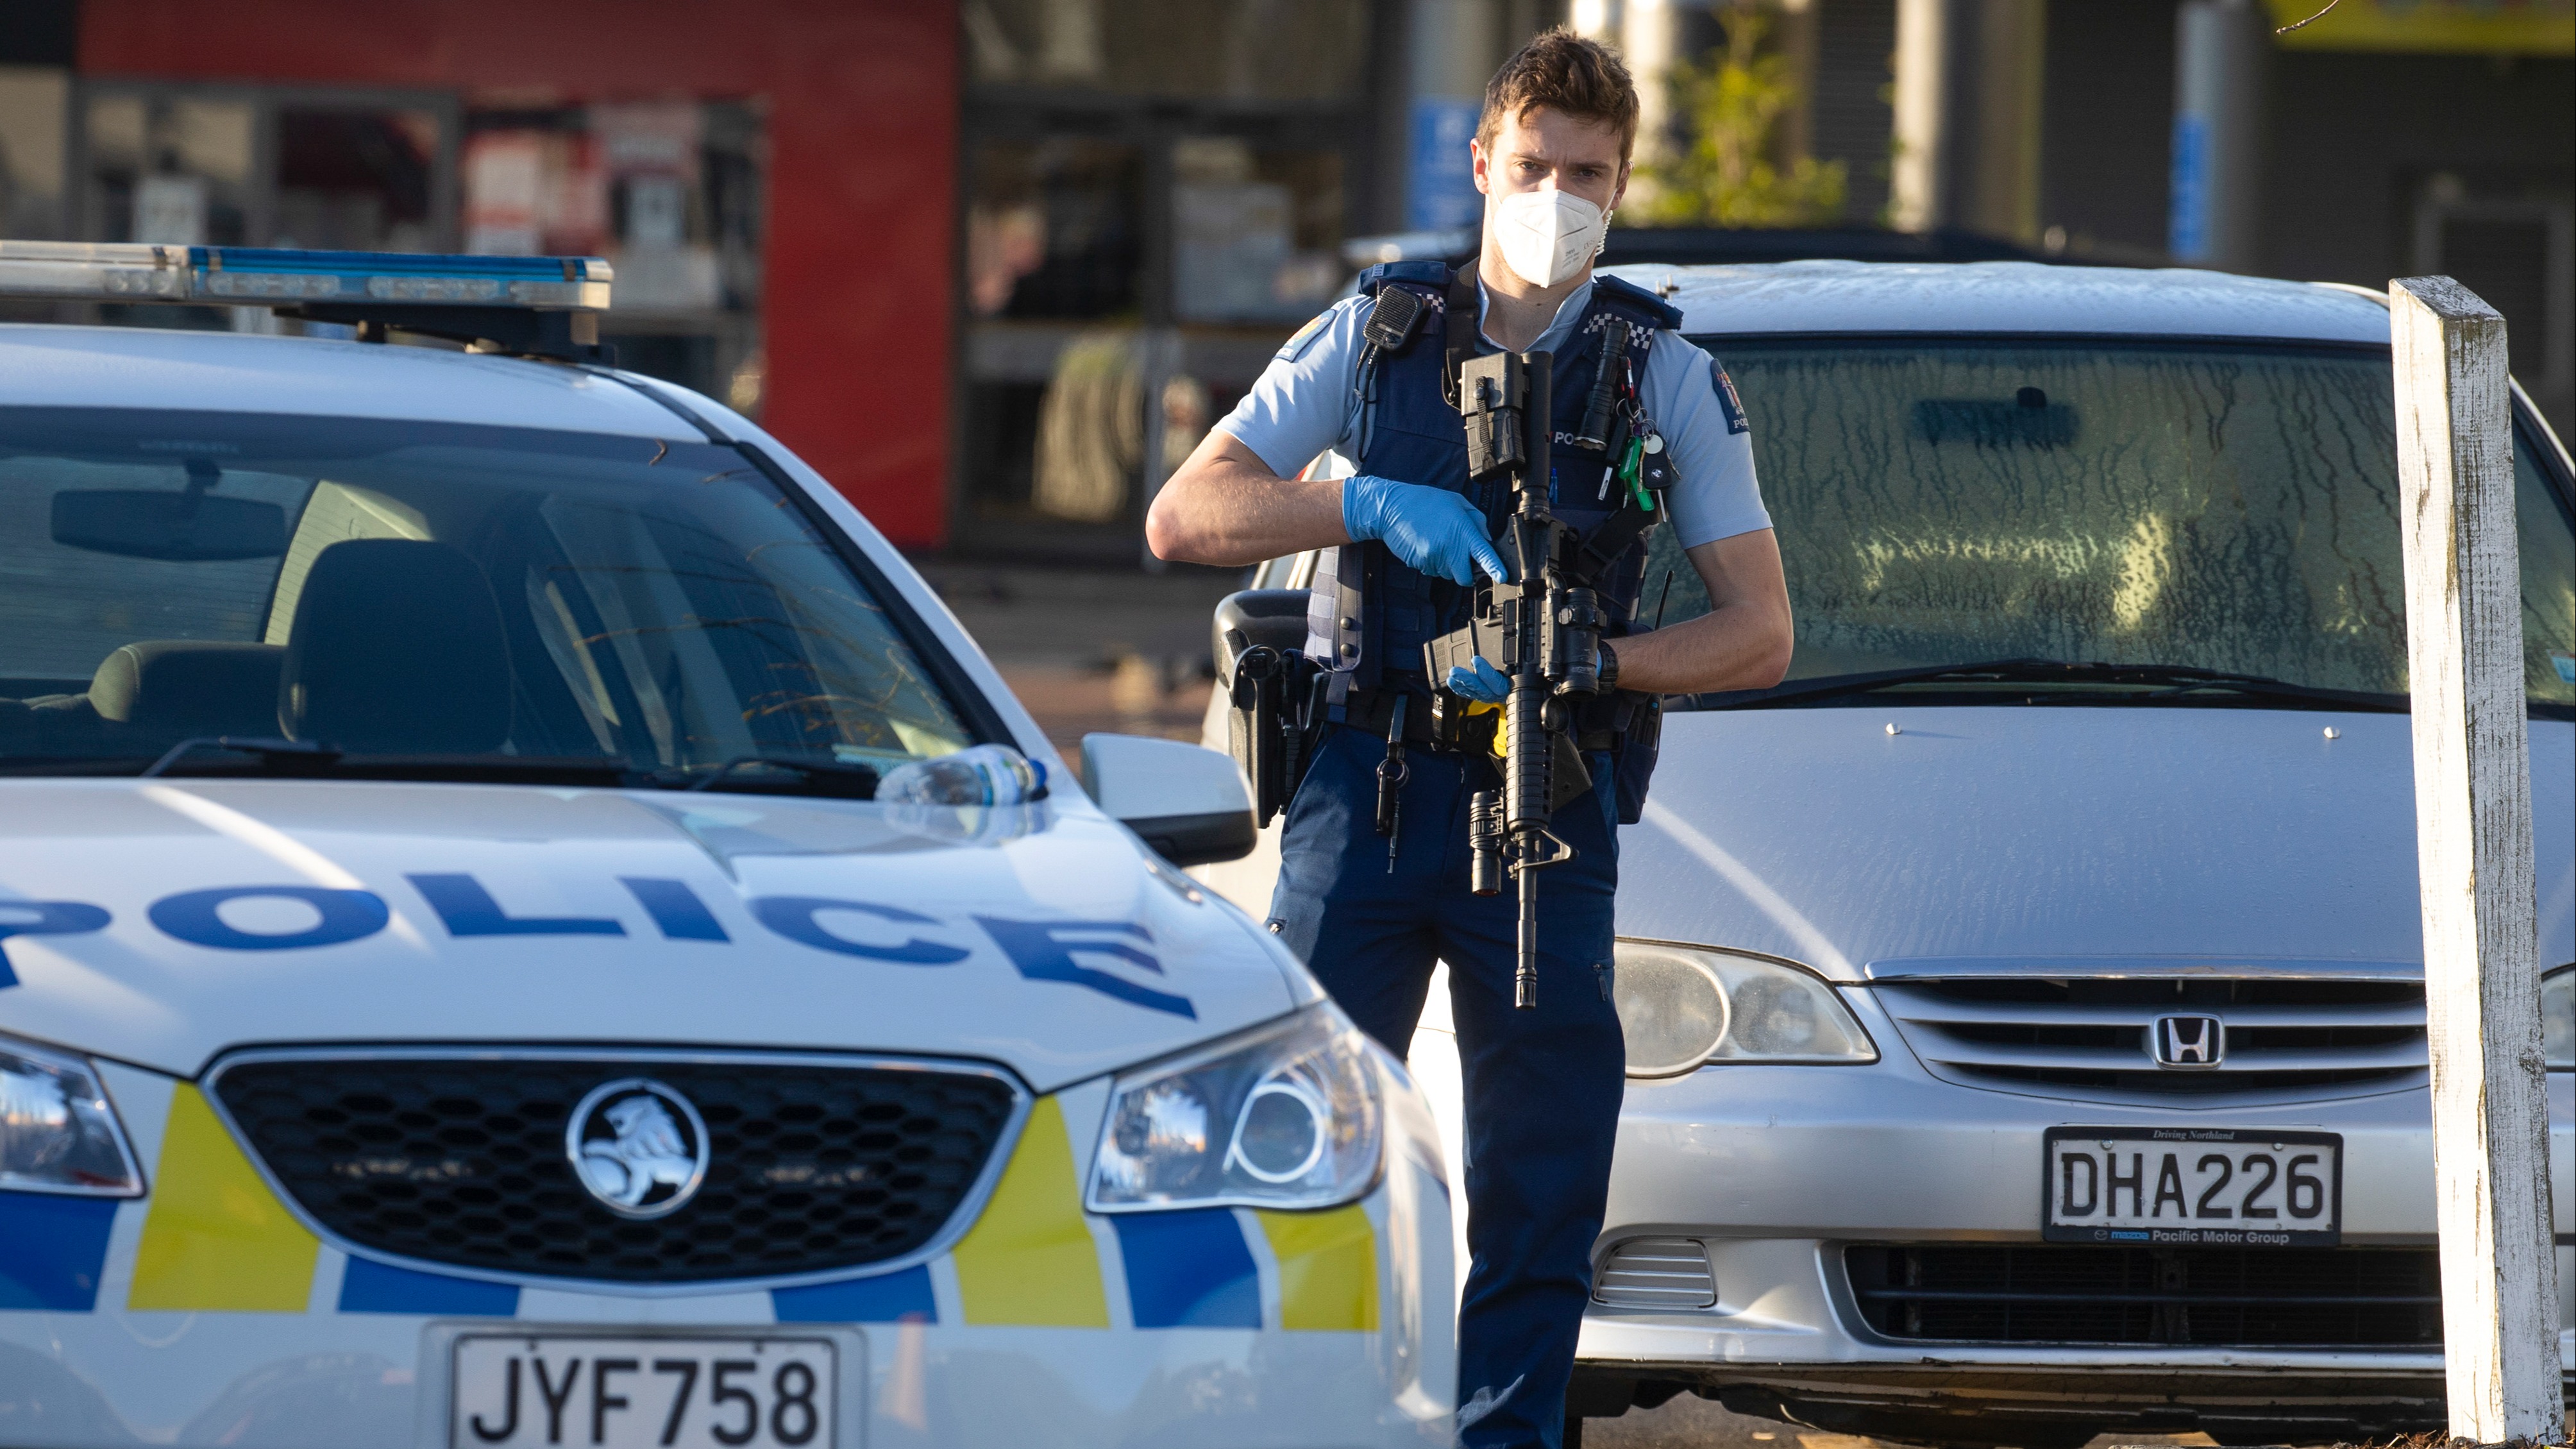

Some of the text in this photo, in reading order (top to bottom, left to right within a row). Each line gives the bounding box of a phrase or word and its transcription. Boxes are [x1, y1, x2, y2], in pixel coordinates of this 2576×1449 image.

[1733, 418, 1749, 428] POL
[2153, 1130, 2235, 1140] Driving Northland
[2060, 1153, 2323, 1219] DHA226
[2153, 1230, 2198, 1242] Pacific
[2203, 1231, 2243, 1242] Motor
[2246, 1232, 2289, 1245] Group
[470, 1357, 820, 1446] JYF758
